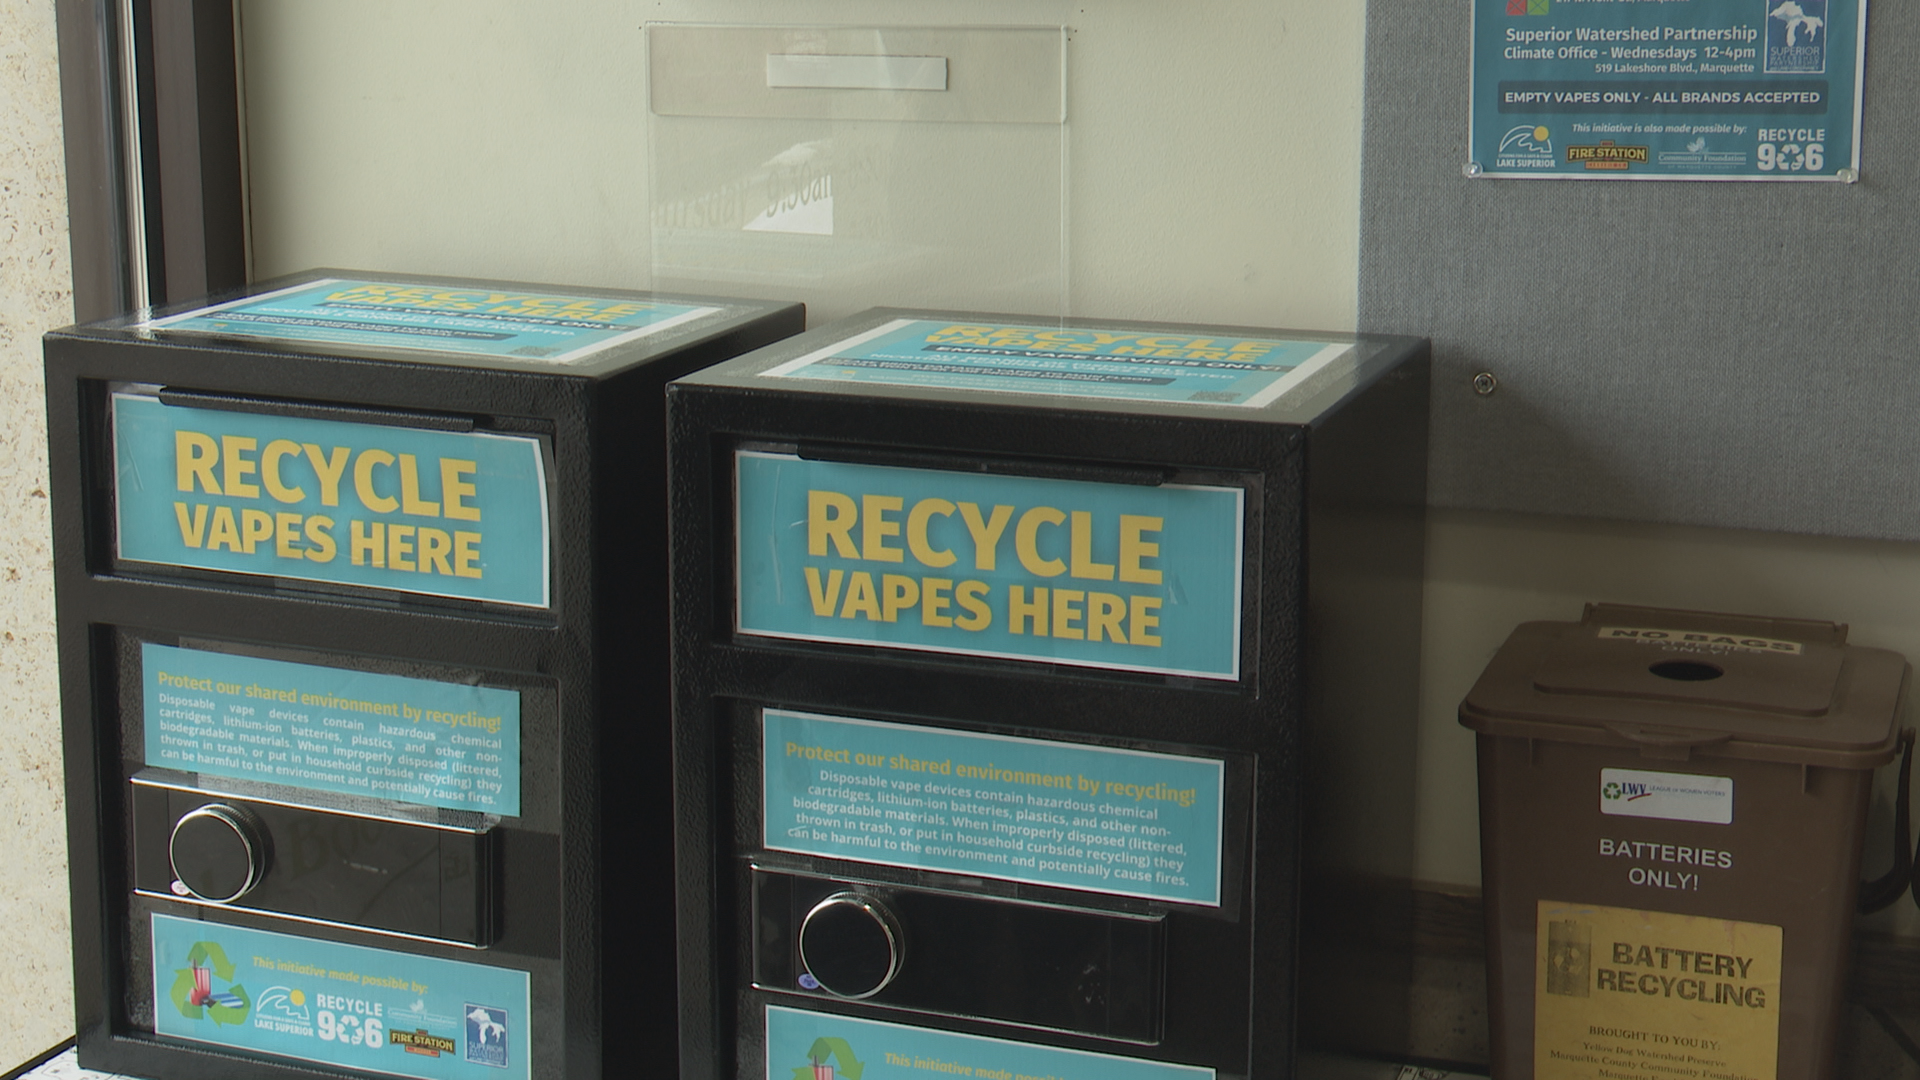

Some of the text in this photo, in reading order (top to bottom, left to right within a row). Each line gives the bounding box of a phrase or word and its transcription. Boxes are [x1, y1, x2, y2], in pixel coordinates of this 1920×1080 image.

[1505, 26, 1757, 45] Superior Watershed Partnership
[1503, 45, 1555, 58] Climate
[1557, 45, 1598, 58] Office
[1610, 45, 1697, 62] Wednesdays
[1703, 44, 1755, 62] 12-4pm
[1770, 47, 1820, 55] SUPERIOR
[1594, 63, 1754, 75] 519 Lakeshore Blvd., Marquette
[1504, 92, 1820, 102] EMPTY VAPES ONLY ALL BRANDS ACCEPTED
[1572, 122, 1732, 135] This initiative also made possible
[1758, 128, 1826, 142] RECYCLE
[1496, 159, 1556, 168] LAKE SUPERIOR
[1569, 148, 1646, 159] FIRE STATION
[325, 293, 484, 310] VAPES
[487, 306, 629, 322] HERE
[344, 284, 654, 315] RECYCLE
[924, 334, 1264, 362] VAPES HERE
[935, 325, 1280, 353] RECYCLE
[936, 347, 1018, 355] EMPTY
[1024, 351, 1089, 359] VAPE
[1094, 356, 1200, 366] DEVICES
[175, 430, 481, 521] RECYCLE
[174, 502, 482, 578] VAPES HERE
[808, 490, 1164, 585] RECYCLE
[804, 568, 1163, 648] VAPES HERE
[1612, 630, 1669, 638] NO
[1683, 634, 1795, 650] BAGS
[158, 671, 500, 733] Protect our shared environment by recycling!
[158, 692, 502, 750] Disposable vape devices contain hazardous chemical
[158, 708, 502, 763] cartridges, lithium-ion batteries, plastics, other non-
[159, 719, 501, 781] biodegradable materials. When improperly disposed (littered,
[160, 732, 502, 795] thrown trash, household curbside recycling) they
[196, 751, 496, 805] harmful environment potentially cause fires.
[785, 741, 1195, 806] Protect our shared environment by recycling!
[1622, 782, 1646, 795] LWV
[819, 768, 1158, 820] Disposable vape devices contain hazardous chemical
[807, 784, 1171, 836] cartridges, lithium-ion batteries, plastics, and other non-
[792, 795, 1186, 858] biodegradable materials. When improperly disposed (littered,
[795, 811, 1184, 873] thrown trash, put household curbside recycling) they
[1599, 838, 1733, 869] BATTERIES
[830, 830, 1188, 886] harmful the environment and potentially cause fires.
[1628, 867, 1699, 892] ONLY!
[253, 955, 428, 996] This initiative made possible by:
[1613, 942, 1754, 979] BATTERY
[1597, 968, 1766, 1009] RECYCLING
[317, 993, 382, 1016] RECYCLE
[1589, 1026, 1720, 1051] BROUGHT TO YOU BY:
[884, 1052, 910, 1067] This
[914, 1056, 972, 1077] initiative
[975, 1068, 1012, 1080] made
[1550, 1050, 1699, 1078] Marquette County Community
[1582, 1042, 1727, 1068] Yellow Dog Watershed Preserve
